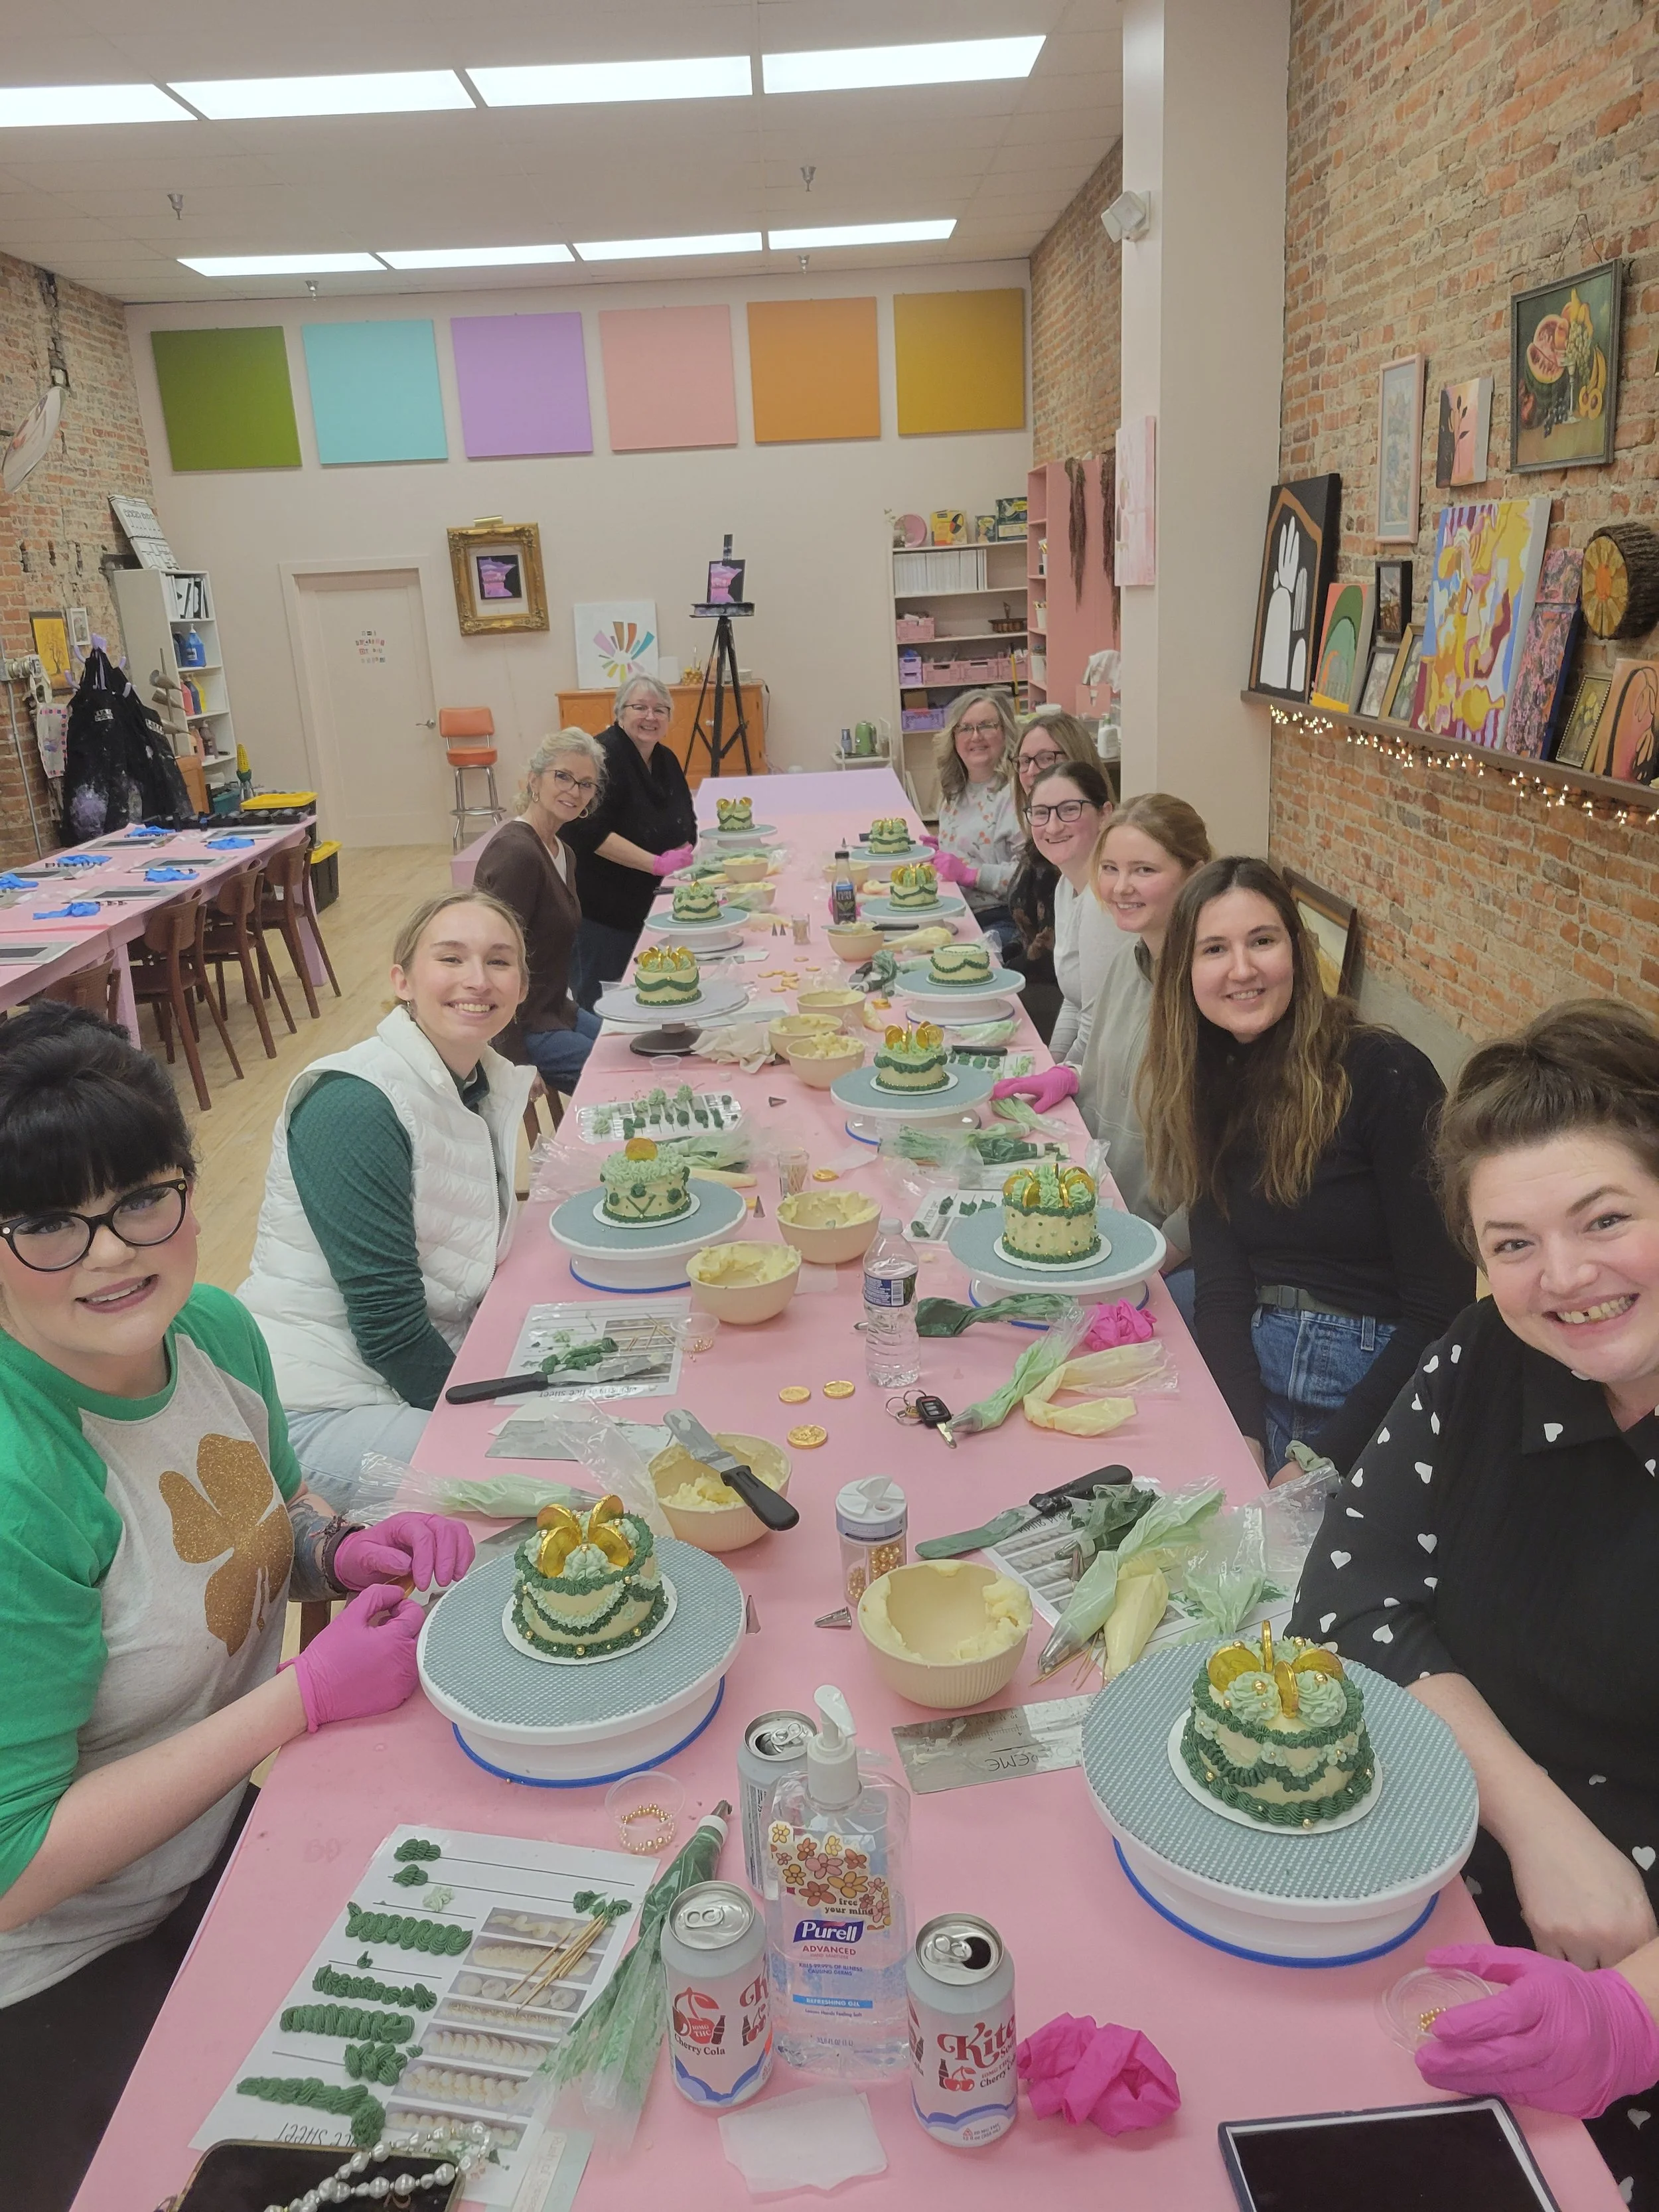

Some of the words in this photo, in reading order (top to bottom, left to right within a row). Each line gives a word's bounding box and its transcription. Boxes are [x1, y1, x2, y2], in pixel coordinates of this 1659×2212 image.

[801, 1921, 857, 1942] Purell
[802, 1945, 856, 1955] ADVANCED
[806, 1997, 846, 2006] REFRESHING
[674, 2033, 702, 2056] Cherry
[703, 2047, 726, 2055] Cola
[979, 2070, 1006, 2088] Cherry
